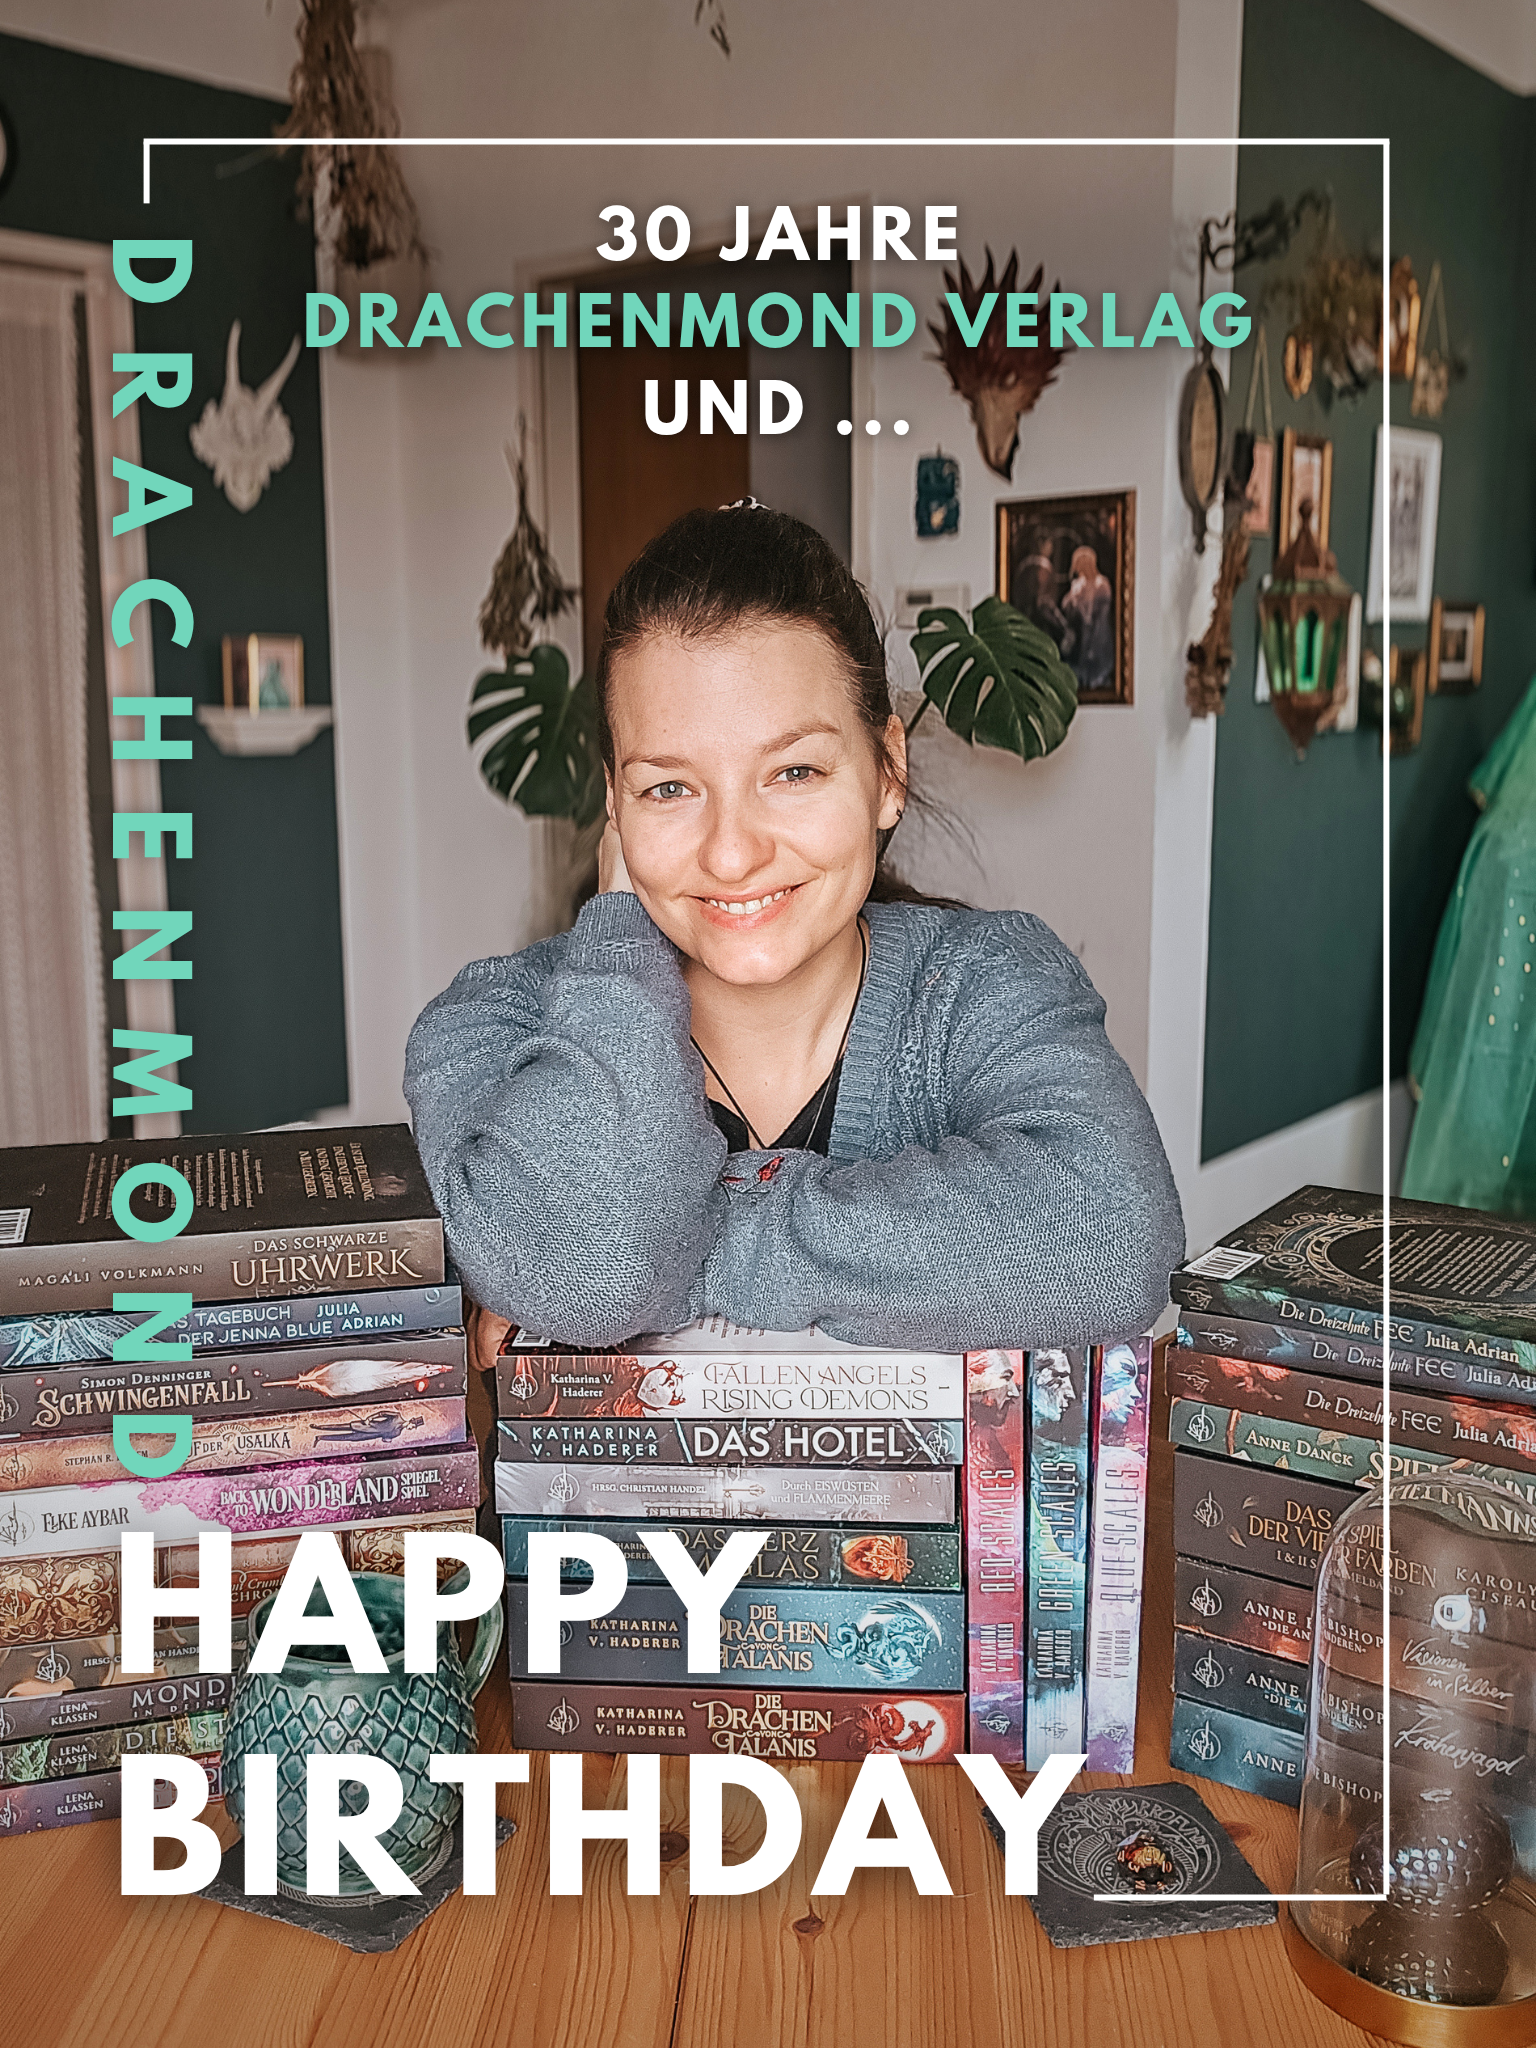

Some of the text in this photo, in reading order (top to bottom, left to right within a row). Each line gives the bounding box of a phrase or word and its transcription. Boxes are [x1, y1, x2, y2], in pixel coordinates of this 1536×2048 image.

[254, 1232, 388, 1252] DAS SCHWARZE
[101, 1264, 203, 1281] VOLKMANN
[232, 1248, 422, 1286] UHRWERK
[196, 1306, 291, 1327] TAGEBUCH
[317, 1302, 360, 1318] JULIA
[178, 1320, 332, 1346] DER JENNA BLUE
[342, 1314, 403, 1330] ADRIAN
[1280, 1300, 1520, 1364] Die Dreizehnte FEE Julia Adrian
[704, 1362, 926, 1386] FALLEN ANGELS
[1312, 1341, 1339, 1361] Die
[1415, 1356, 1457, 1379] FEE
[1466, 1365, 1502, 1386] Julia
[550, 1374, 614, 1385] Katharina V.
[562, 1387, 604, 1398] Haderer
[701, 1387, 929, 1412] RISING DEMONS
[1304, 1390, 1332, 1412] Die
[1401, 1410, 1442, 1434] FEE
[1452, 1422, 1488, 1443] Julia
[203, 1442, 223, 1453] DER
[222, 1431, 291, 1456] RUSALKA
[532, 1426, 657, 1440] KATHARINA
[694, 1426, 904, 1458] DAS HOTEL
[531, 1444, 658, 1457] V. HADERER
[1246, 1429, 1354, 1468] ANNE DANCK
[64, 1454, 102, 1467] STEPHAN
[400, 1470, 440, 1486] SPIEGEL
[592, 1483, 707, 1494] HRSG. CHRISTIAN HANDEL
[782, 1479, 880, 1492] Durch EISWÜSTEN
[220, 1489, 249, 1506] BACK
[250, 1476, 399, 1516] WONDERLAND
[401, 1485, 429, 1500] SPIEL
[771, 1492, 891, 1506] und FLAMMENMEERE
[81, 1507, 130, 1529] AYBAR
[233, 1504, 249, 1518] TO
[1286, 1500, 1332, 1530] DAS
[980, 1469, 1016, 1593] RED SCALES
[1038, 1462, 1076, 1612] GREEN SCALES
[1100, 1469, 1140, 1603] BLUE SCALES
[1249, 1515, 1289, 1544] DER
[1284, 1552, 1296, 1564] &
[750, 1604, 777, 1620] DIE
[1244, 1600, 1297, 1626] ANNE
[590, 1618, 678, 1632] KATHARINA
[1328, 1618, 1384, 1649] BISHOP
[588, 1636, 681, 1649] V. HADERER
[980, 1624, 997, 1672] KATHARINA
[997, 1623, 1014, 1660] HADERER
[1054, 1630, 1072, 1666] HADERER
[1114, 1630, 1131, 1666] HADERER
[1035, 1630, 1054, 1678] KATHARINA
[1096, 1630, 1114, 1678] KATHARINA
[1246, 1672, 1300, 1698] ANNE
[1426, 1672, 1442, 1688] in
[60, 1702, 88, 1714] LENA
[597, 1707, 684, 1720] KATHARINA
[755, 1694, 782, 1710] DIE
[1328, 1694, 1384, 1725] BISHOP
[51, 1711, 98, 1726] KLASSEN
[692, 1700, 832, 1734] DRACHEN
[126, 1726, 177, 1750] DIE
[596, 1724, 687, 1738] V. HADERER
[60, 1744, 88, 1756] LENA
[712, 1730, 817, 1758] TALANIS
[1394, 1714, 1525, 1778] Krähenjagd
[50, 1752, 97, 1767] KLASSEN
[1242, 1750, 1297, 1778] ANNE
[66, 1791, 94, 1804] LENA
[1324, 1770, 1383, 1803] BISHOP
[57, 1800, 104, 1815] KLASSEN
